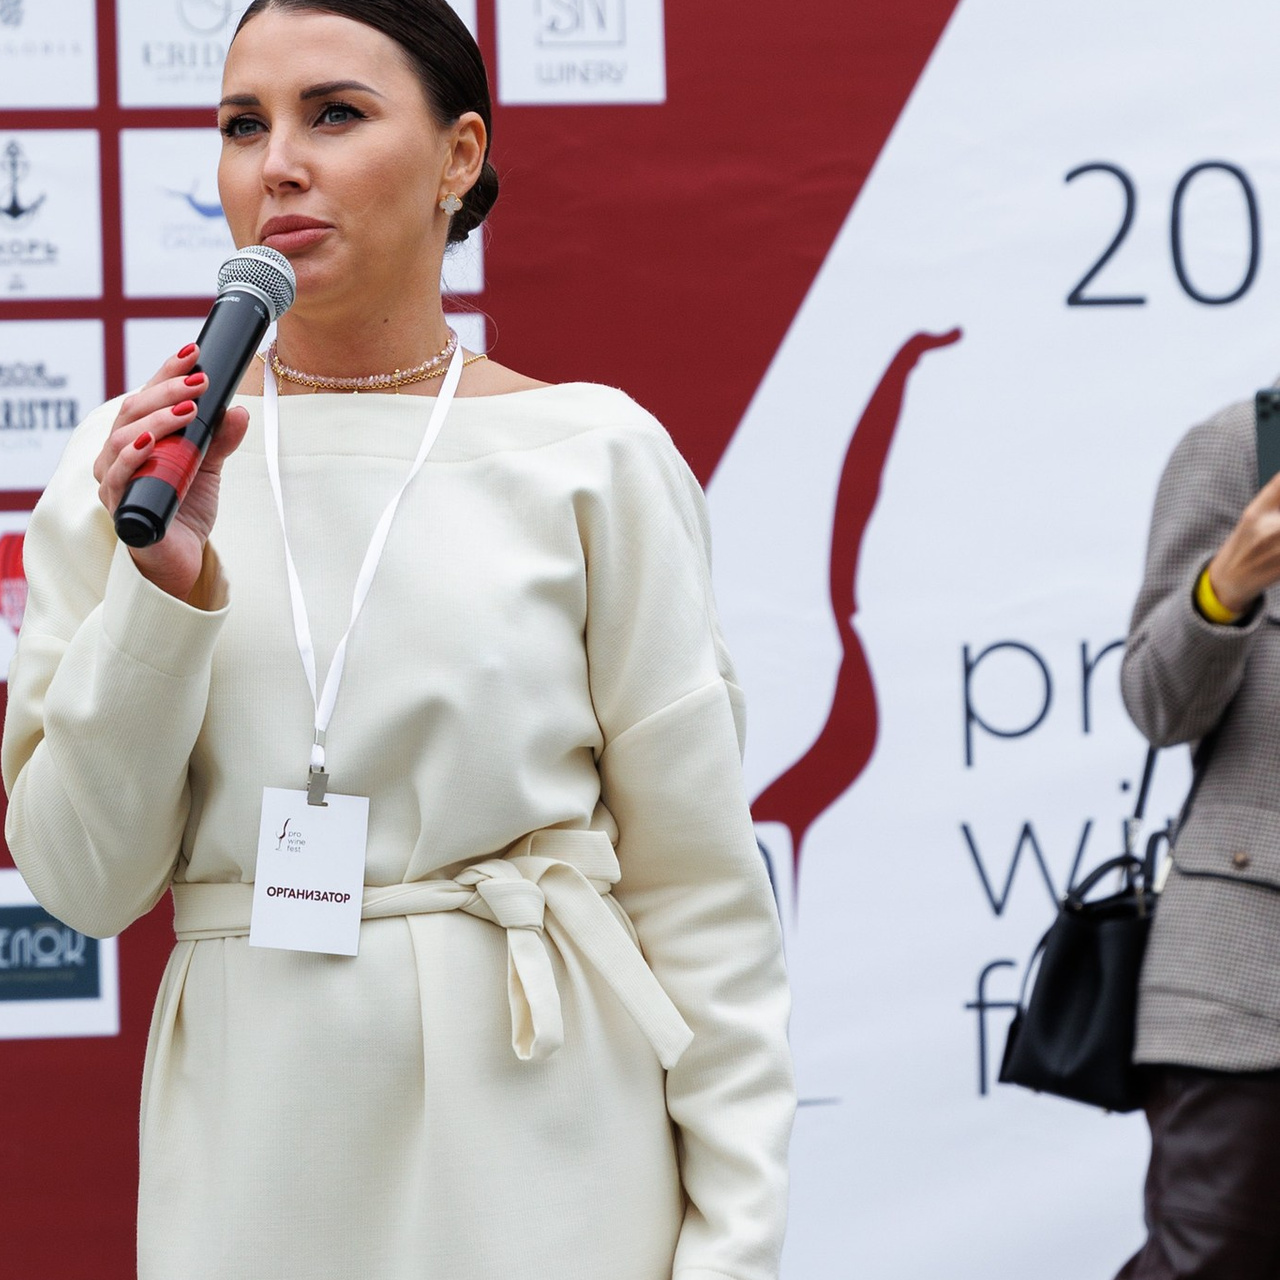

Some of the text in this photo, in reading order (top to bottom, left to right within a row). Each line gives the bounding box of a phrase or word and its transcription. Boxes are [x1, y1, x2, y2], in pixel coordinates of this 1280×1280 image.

[1063, 161, 1263, 307] 20
[961, 639, 1126, 768] pr
[266, 886, 351, 904] ОРГАНИЗАТОР
